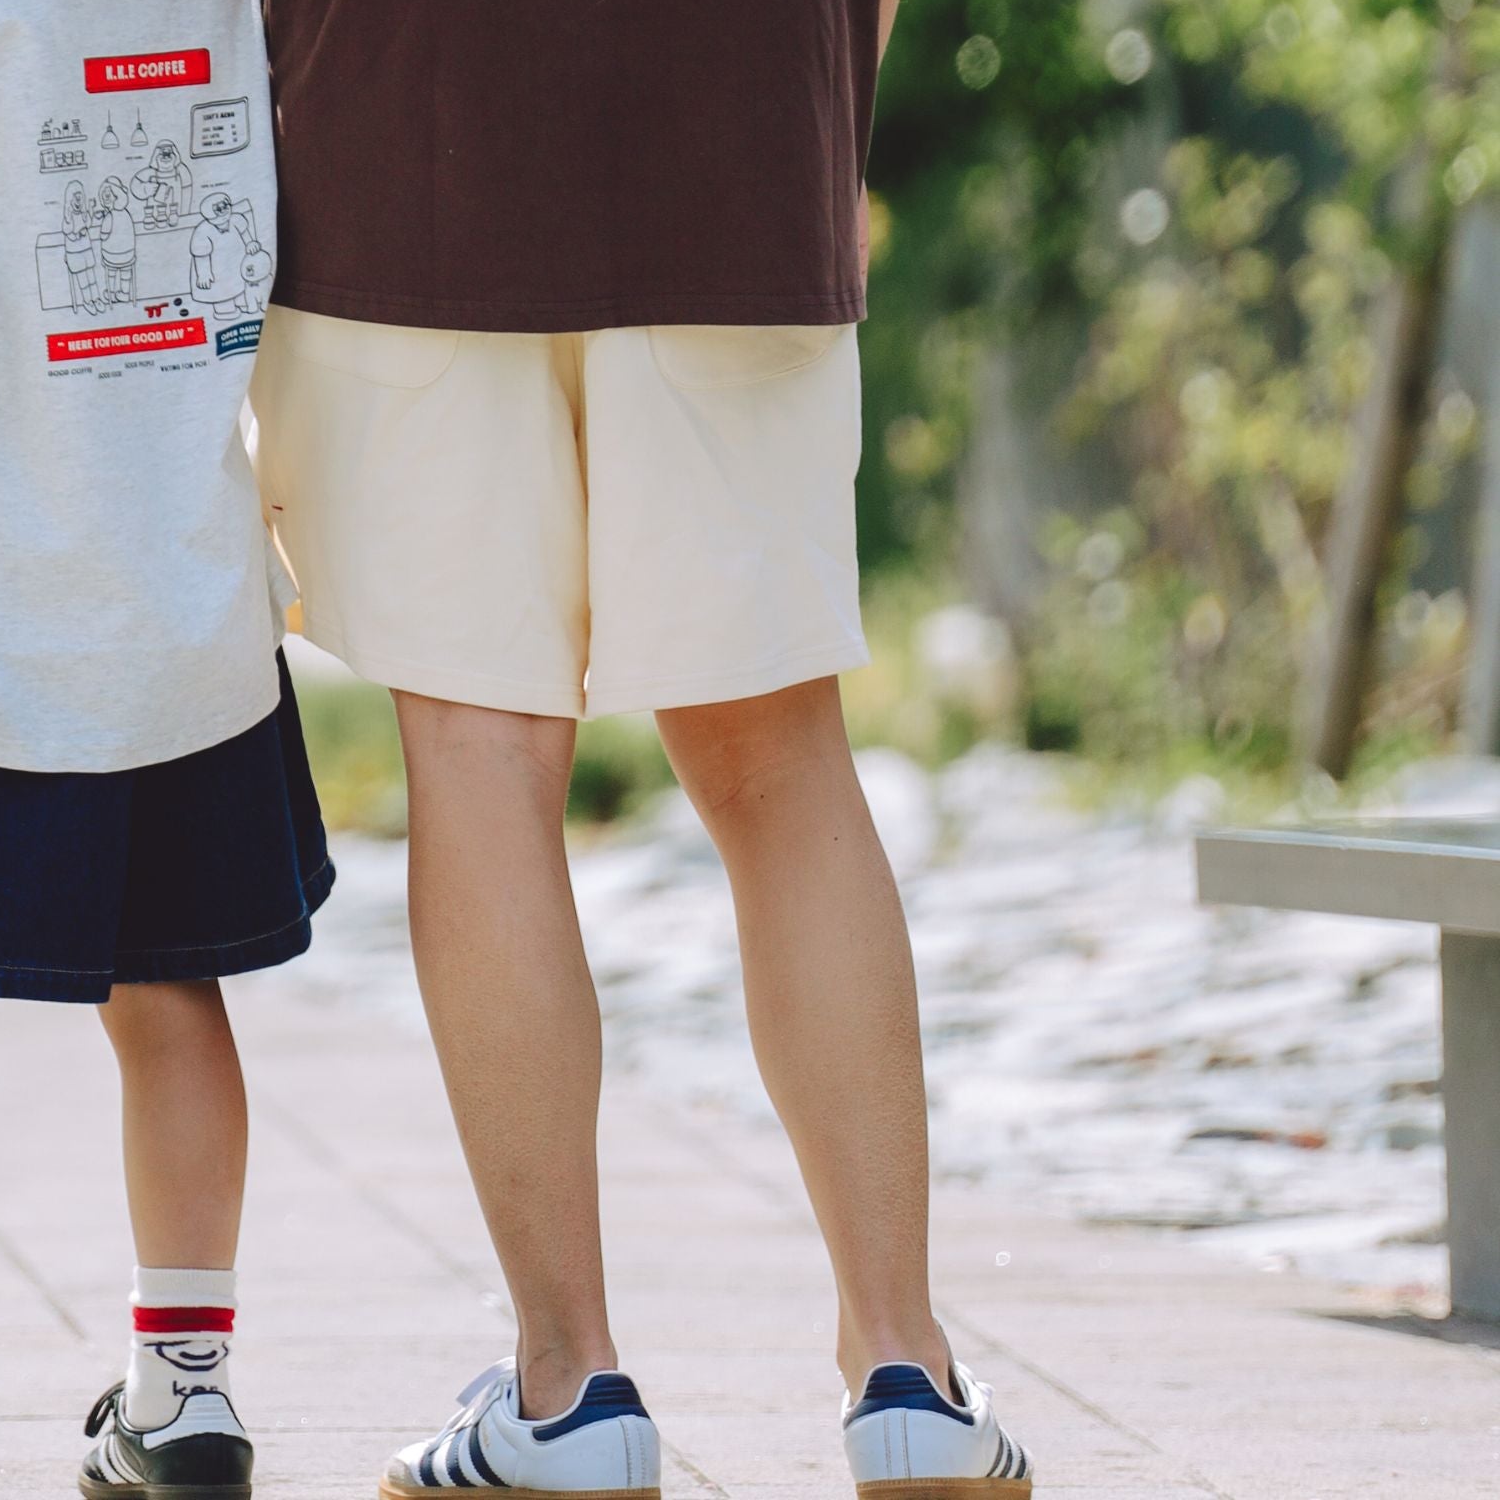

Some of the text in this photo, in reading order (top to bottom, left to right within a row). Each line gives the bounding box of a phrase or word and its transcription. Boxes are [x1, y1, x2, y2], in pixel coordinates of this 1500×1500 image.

[138, 60, 186, 78] COFFEE
[132, 331, 163, 344] GOOD
[164, 328, 185, 340] DAY
